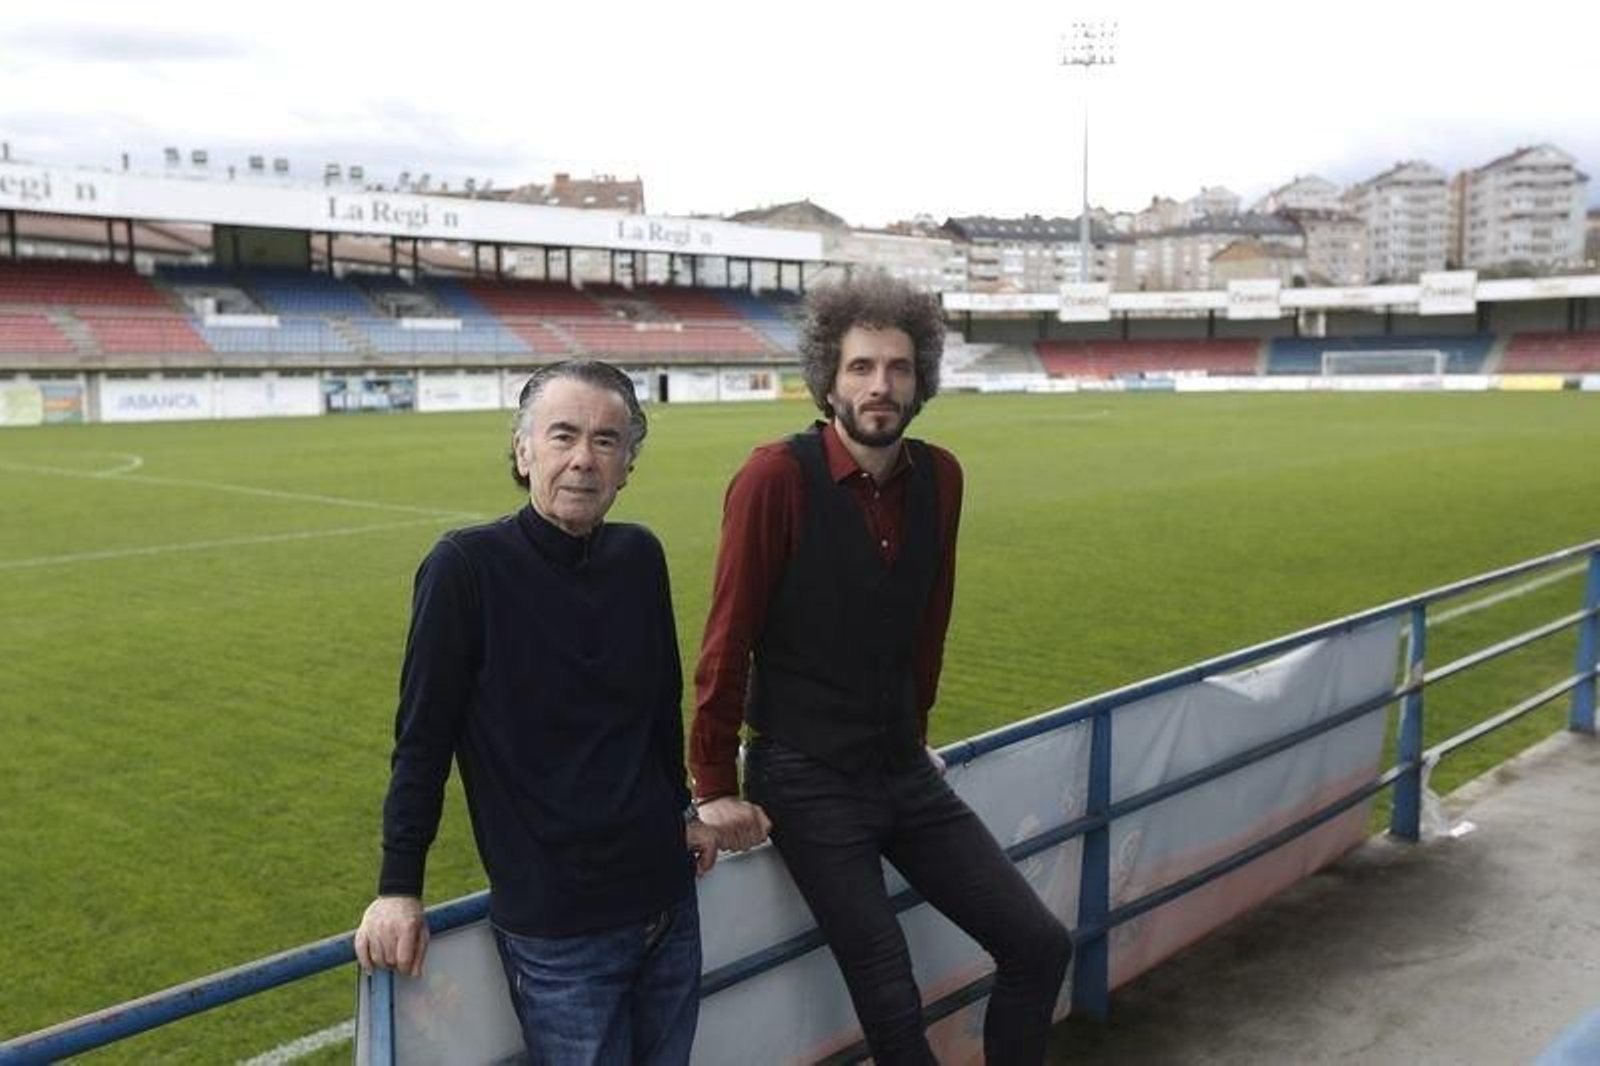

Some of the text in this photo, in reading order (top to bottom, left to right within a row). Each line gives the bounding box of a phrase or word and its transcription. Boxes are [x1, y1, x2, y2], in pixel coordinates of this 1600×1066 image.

[327, 196, 458, 230] La Regin
[617, 220, 713, 247] La Regin
